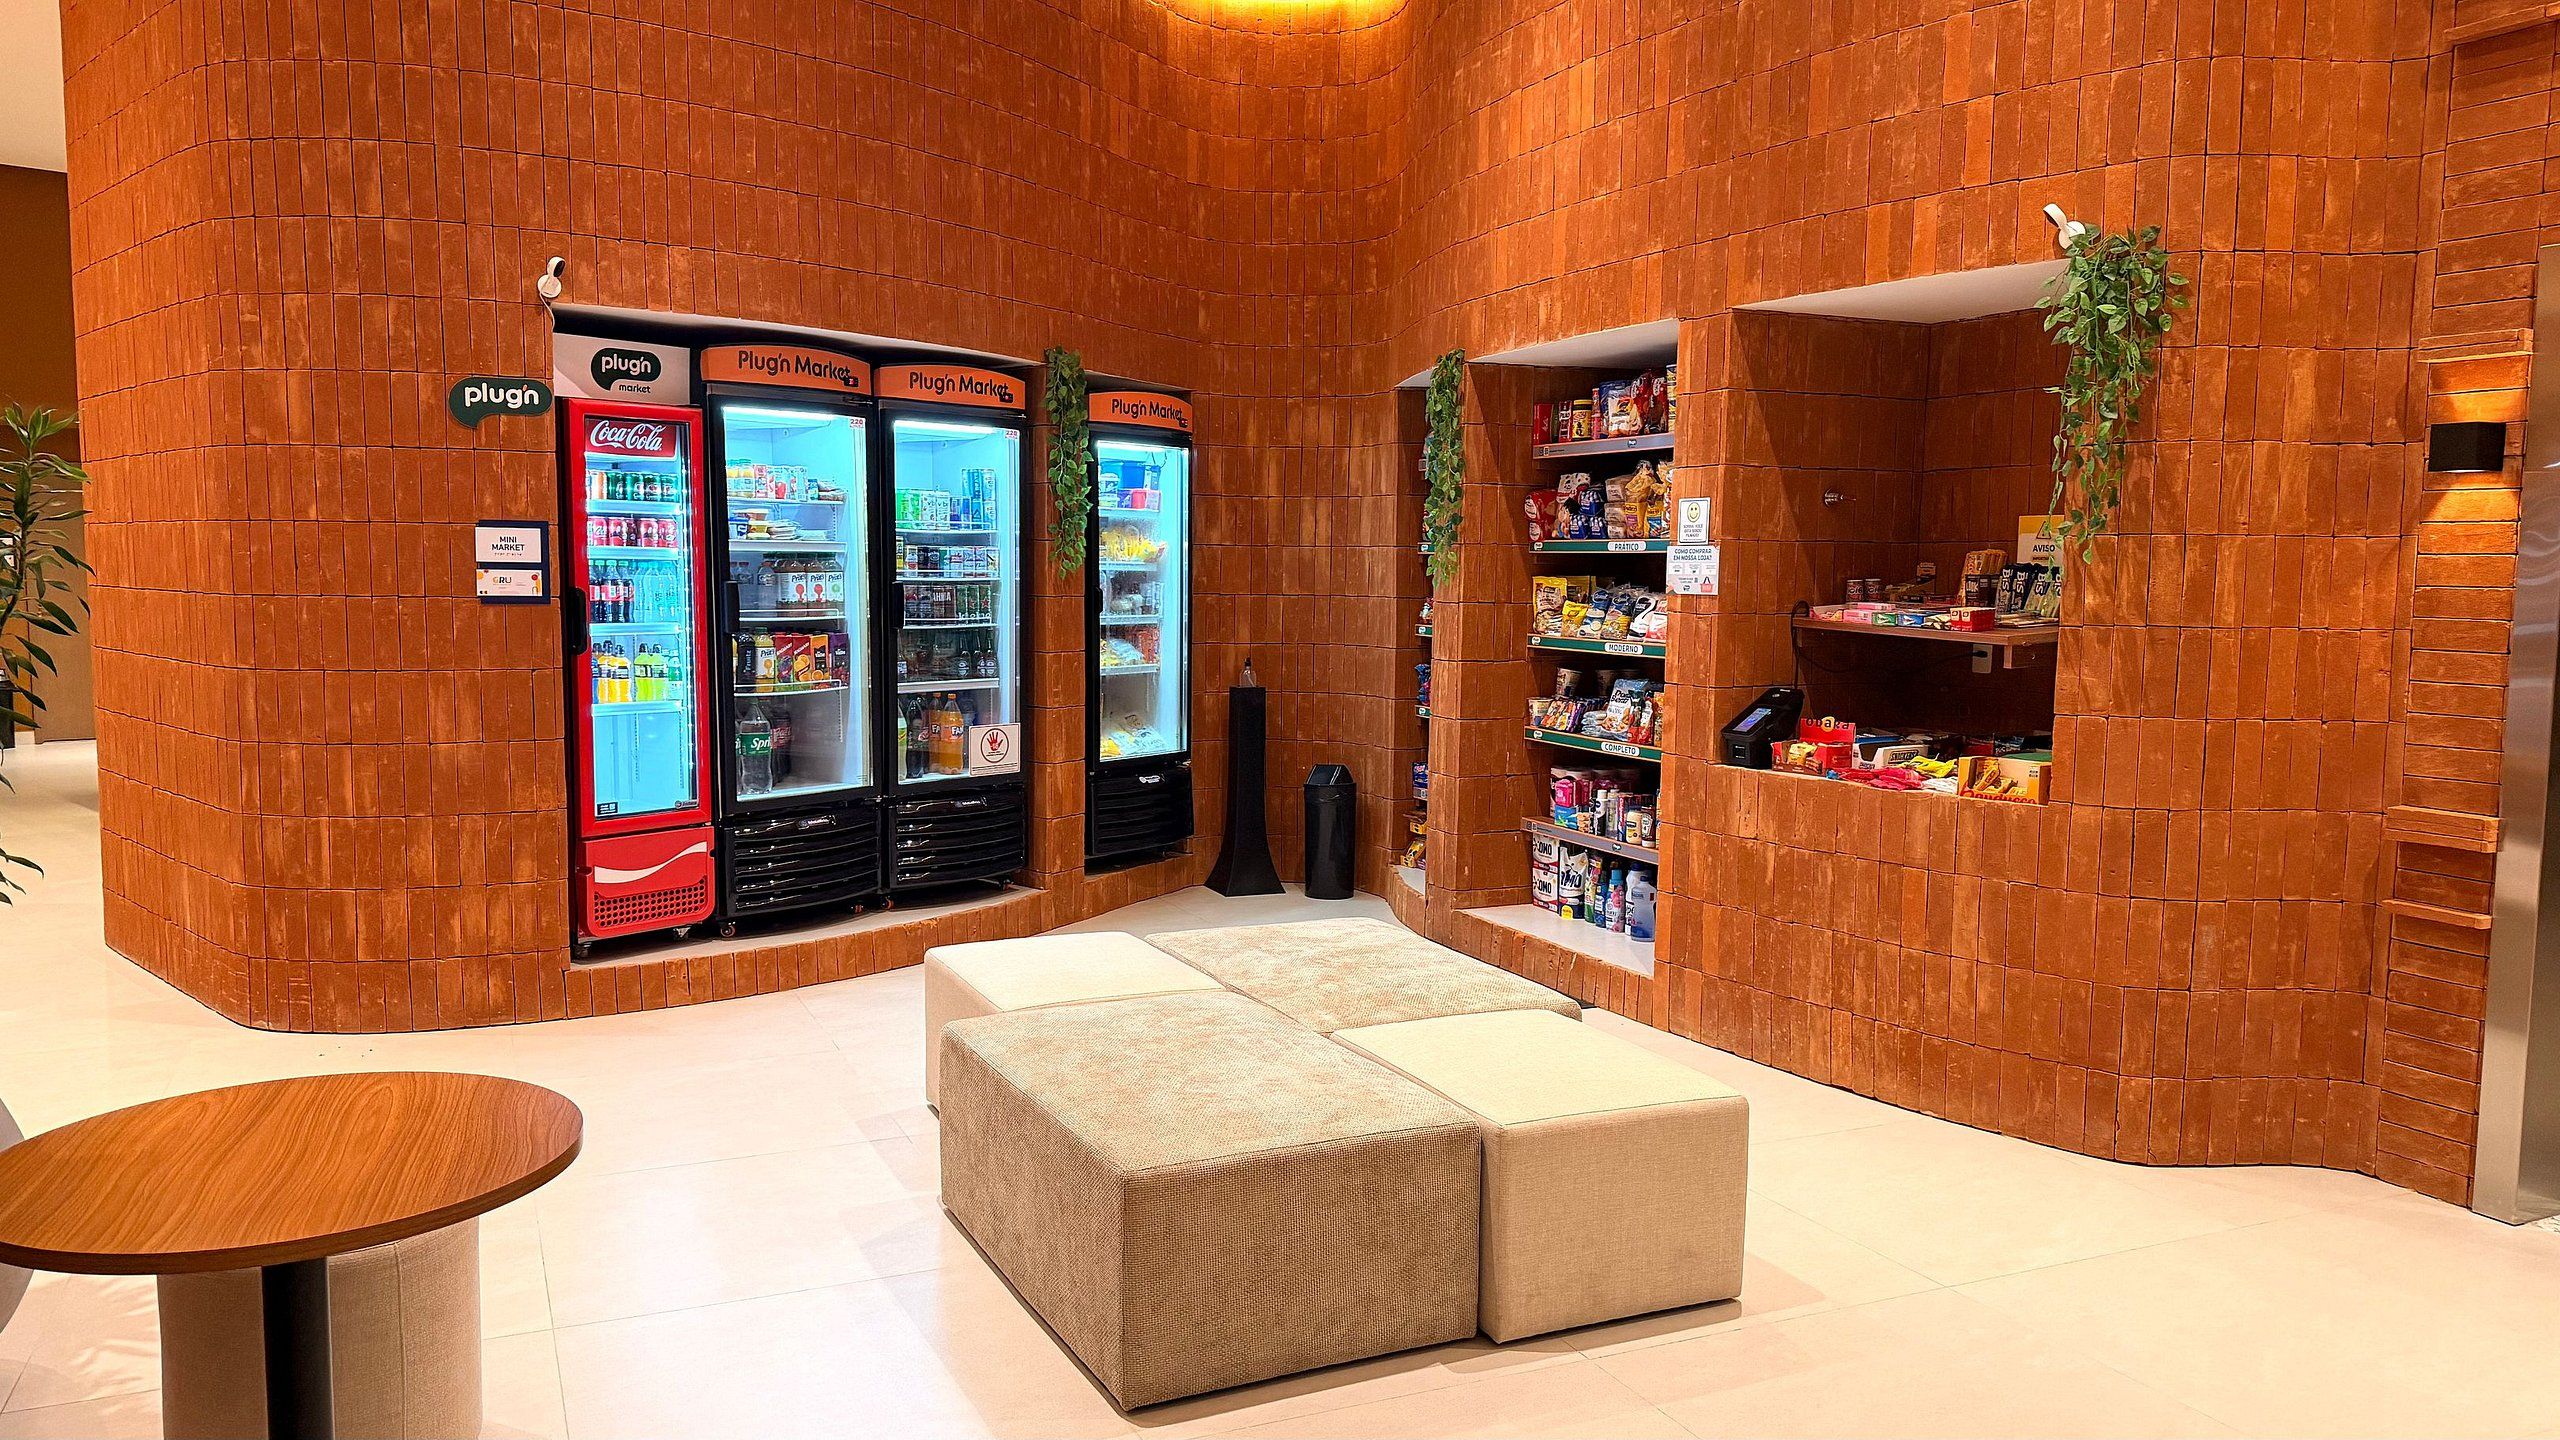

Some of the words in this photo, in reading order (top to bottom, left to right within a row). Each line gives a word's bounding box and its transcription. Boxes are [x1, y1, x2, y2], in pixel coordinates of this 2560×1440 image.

[600, 353, 652, 375] plug'n
[737, 349, 791, 377] Plug'n
[794, 356, 851, 383] Market
[618, 383, 651, 395] market
[909, 371, 956, 397] Plug'n
[958, 376, 1010, 399] Market
[464, 382, 540, 410] plug'n
[1111, 398, 1147, 419] Plug'n
[1148, 401, 1183, 421] Market
[590, 420, 666, 451] Coca-Cola
[491, 543, 525, 551] MARKET
[2032, 544, 2056, 553] AVISO
[492, 576, 512, 584] GRU
[1608, 644, 1639, 653] MODERNO
[1604, 743, 1636, 755] COMPLETO
